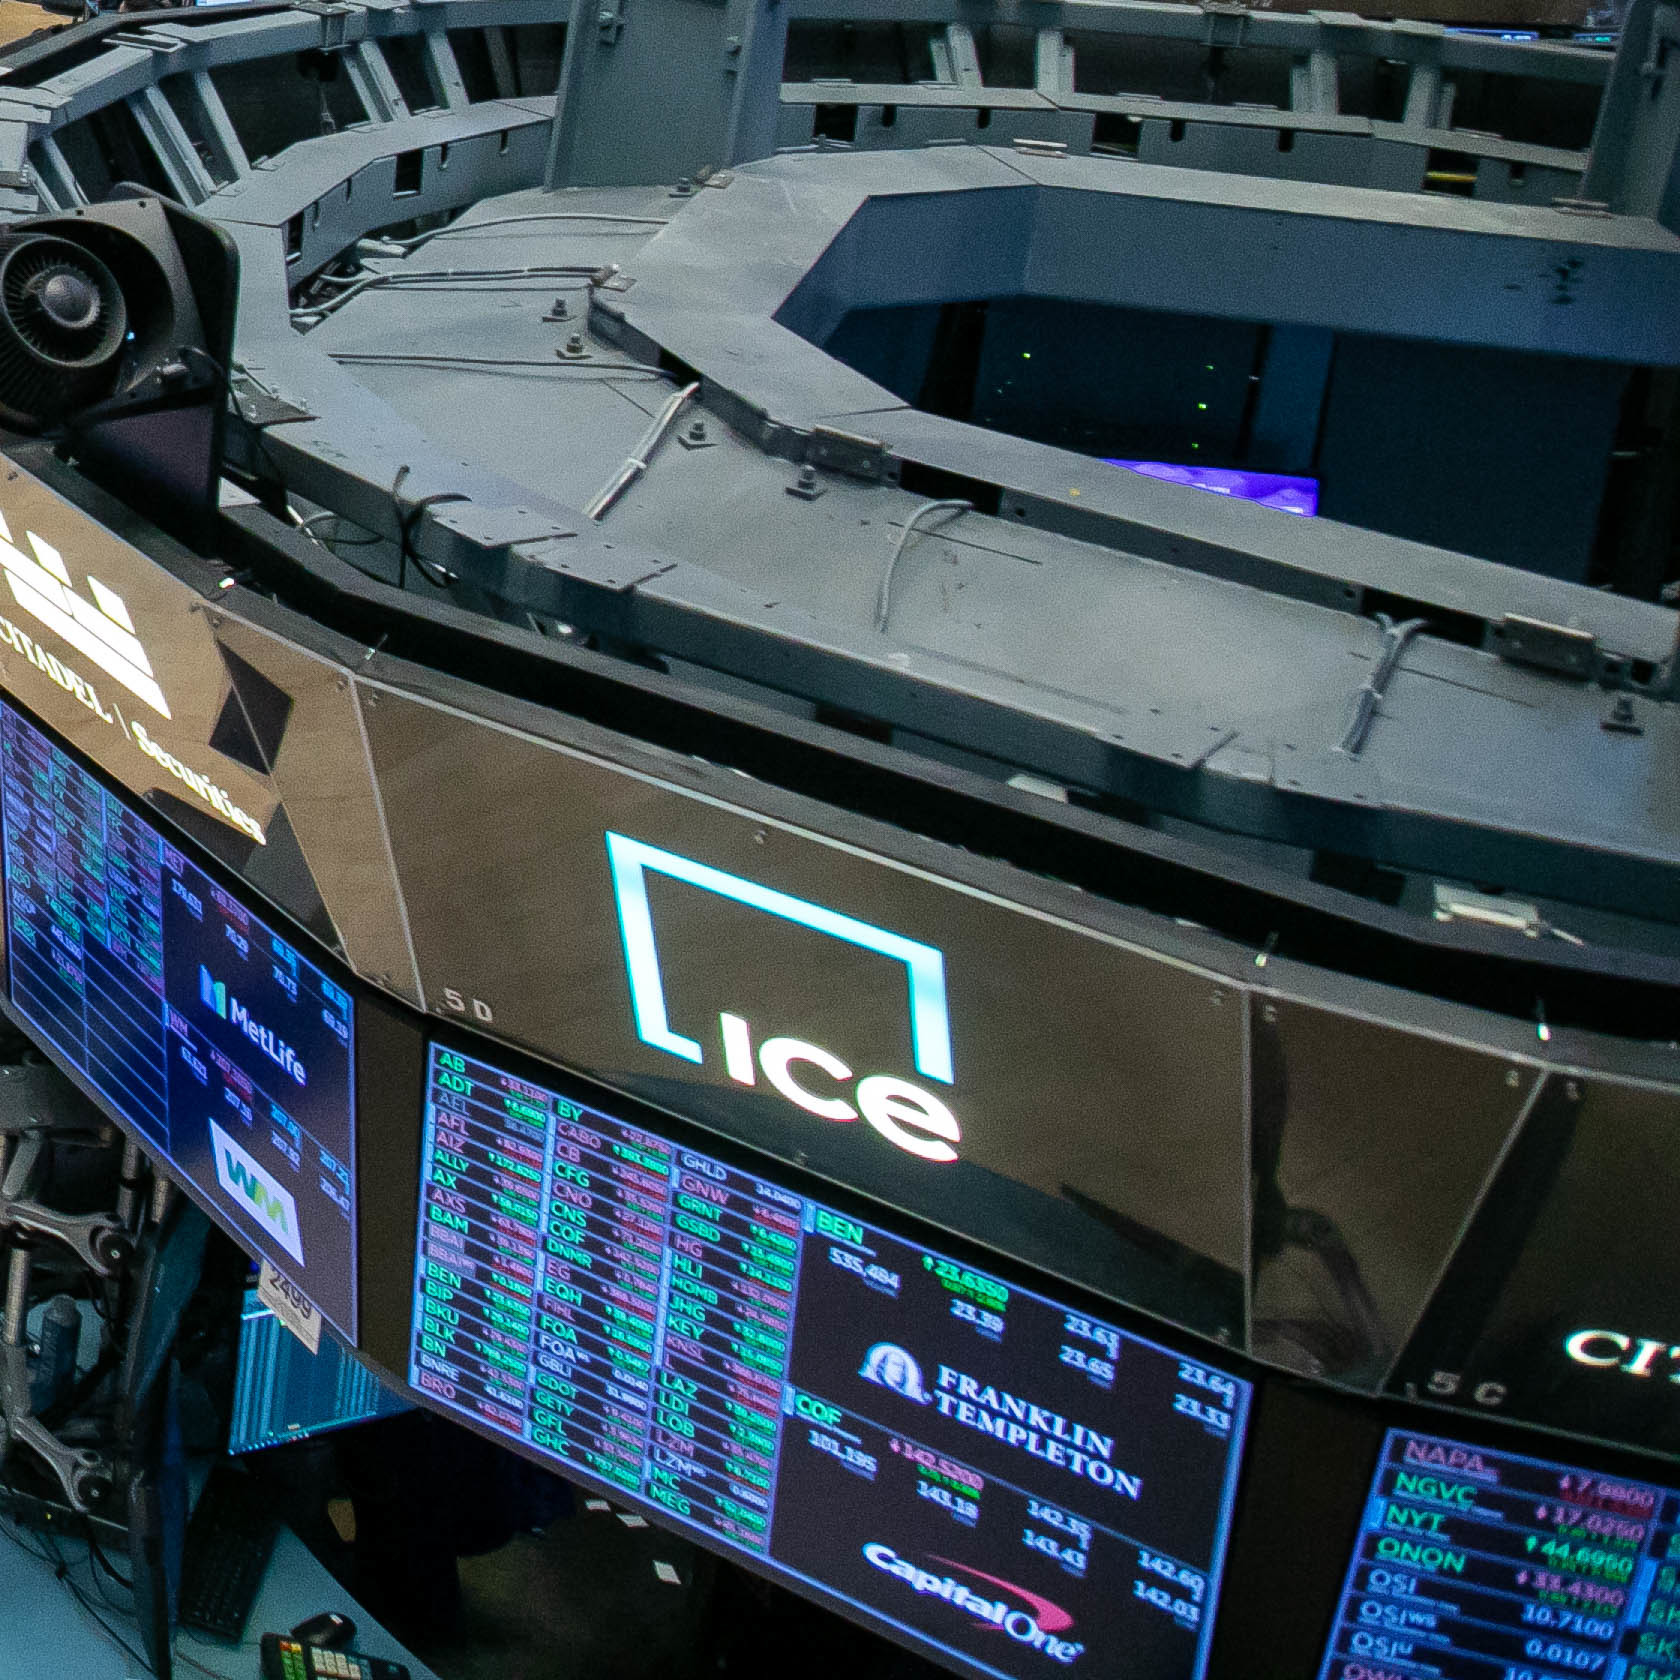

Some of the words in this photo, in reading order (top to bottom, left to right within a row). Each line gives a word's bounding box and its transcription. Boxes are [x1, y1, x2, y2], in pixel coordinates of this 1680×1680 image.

[130, 718, 268, 847] Securities
[229, 994, 308, 1086] MetLife
[816, 1210, 867, 1247] BEN
[268, 1267, 314, 1322] 2499
[933, 1389, 1143, 1501] TEMPLETON
[934, 1365, 1115, 1461] FRANKLIN
